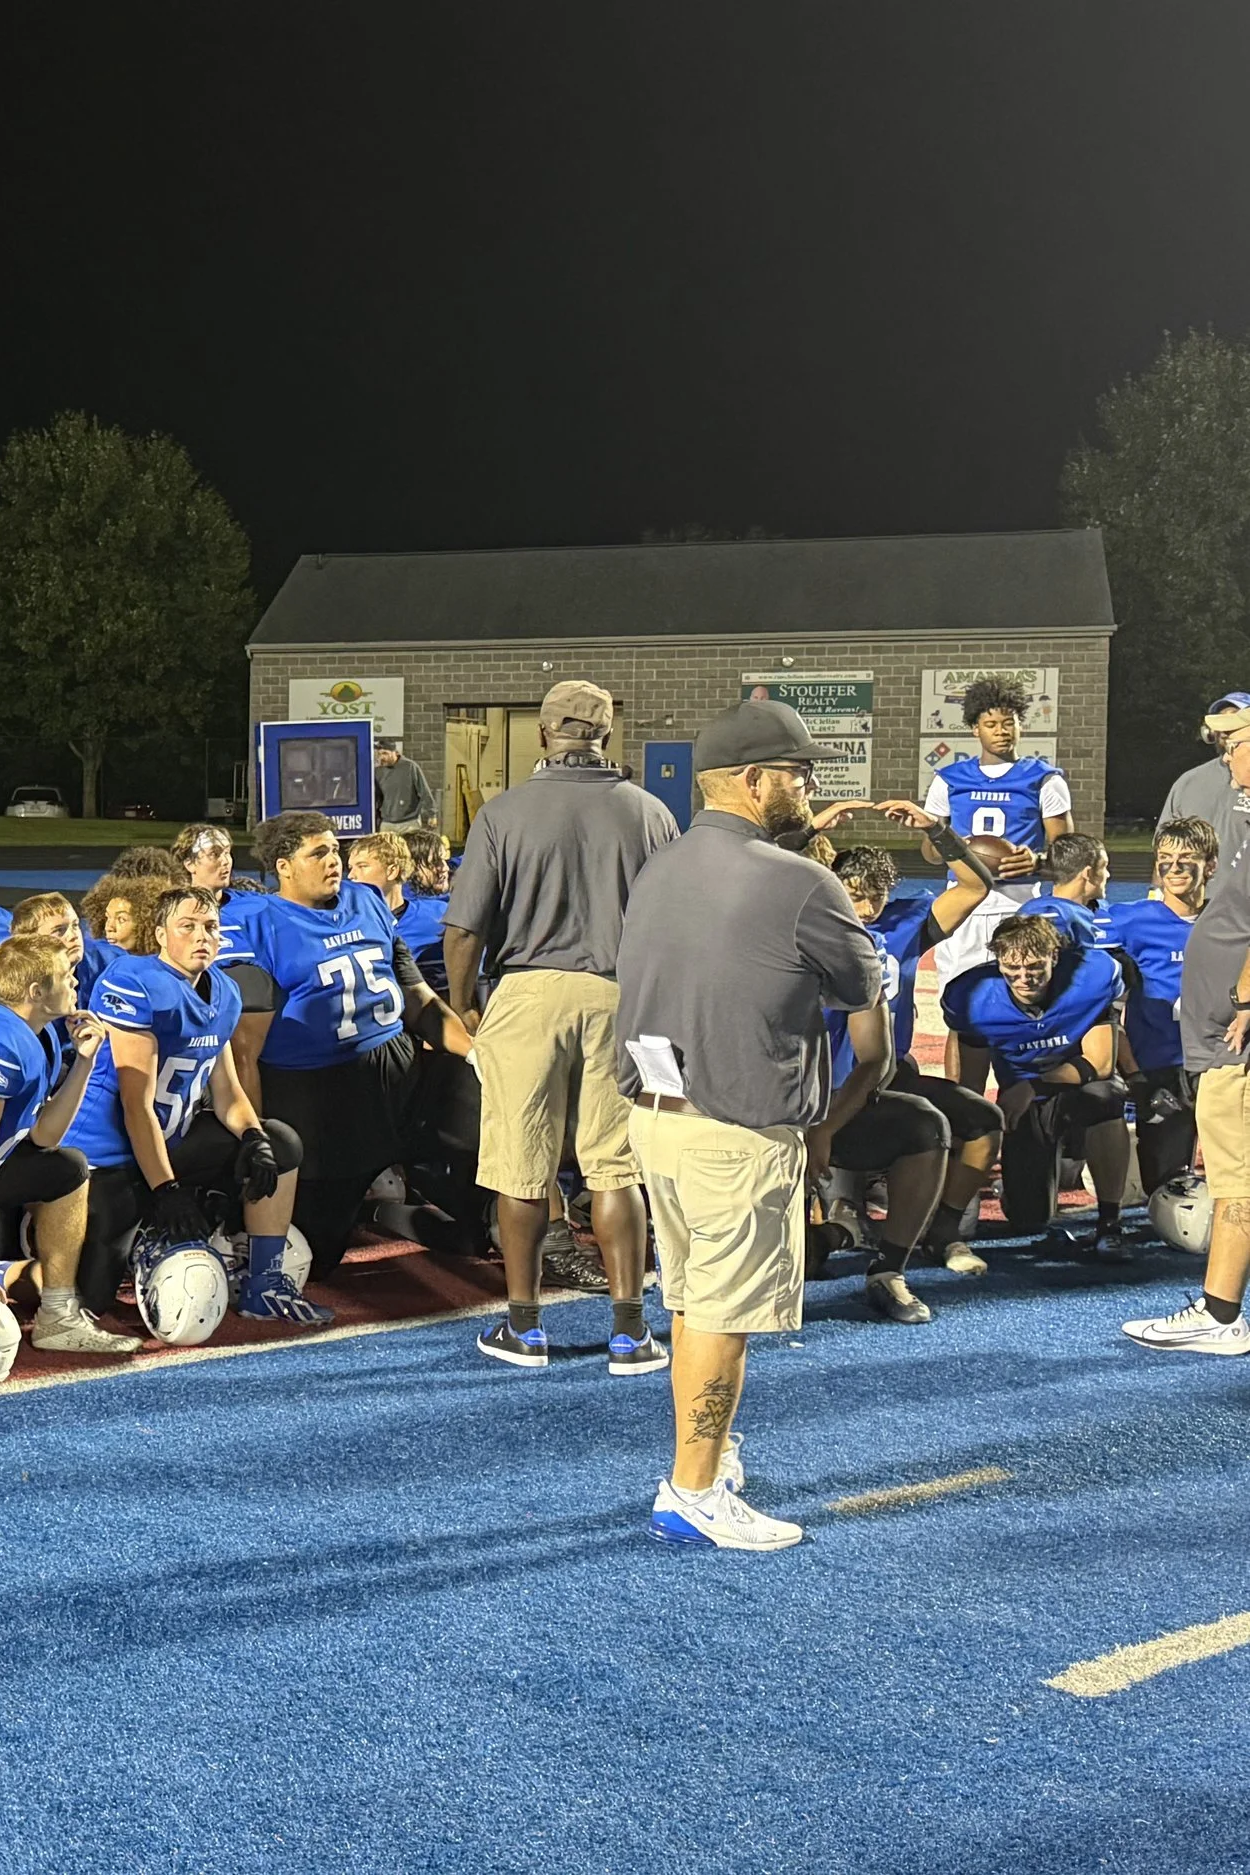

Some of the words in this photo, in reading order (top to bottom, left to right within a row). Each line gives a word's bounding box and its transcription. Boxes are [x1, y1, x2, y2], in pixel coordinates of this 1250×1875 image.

[778, 684, 857, 697] STOUFFER
[317, 701, 375, 715] YOST
[798, 697, 838, 706] REALTY
[813, 787, 866, 798] Ravens!
[970, 791, 1011, 801] RAVENNA
[323, 929, 365, 949] RAVENNA
[318, 947, 402, 1040] 75
[1019, 1035, 1070, 1051] RAVENNA
